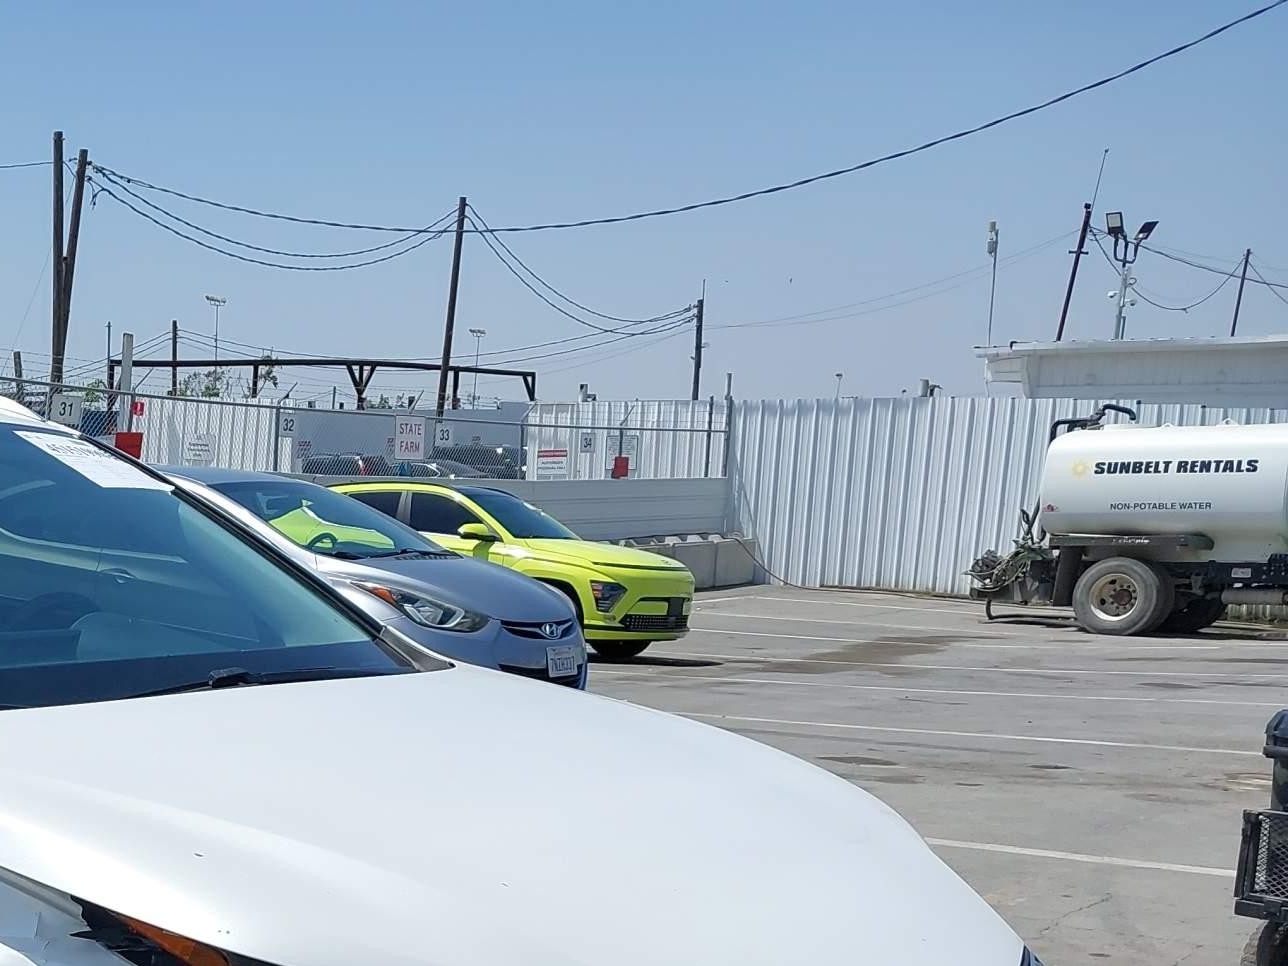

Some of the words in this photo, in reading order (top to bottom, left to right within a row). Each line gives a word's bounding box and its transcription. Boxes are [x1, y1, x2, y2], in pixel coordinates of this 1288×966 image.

[58, 401, 74, 417] 31
[282, 418, 295, 432] 32
[399, 423, 423, 436] STATE
[439, 428, 450, 442] 33
[399, 441, 420, 454] FARM
[583, 437, 592, 449] 34
[1094, 461, 1172, 475] SUNBELT
[1176, 459, 1260, 474] RENTALS
[1110, 502, 1176, 511] NON-POTABLE
[1179, 502, 1212, 511] WATER
